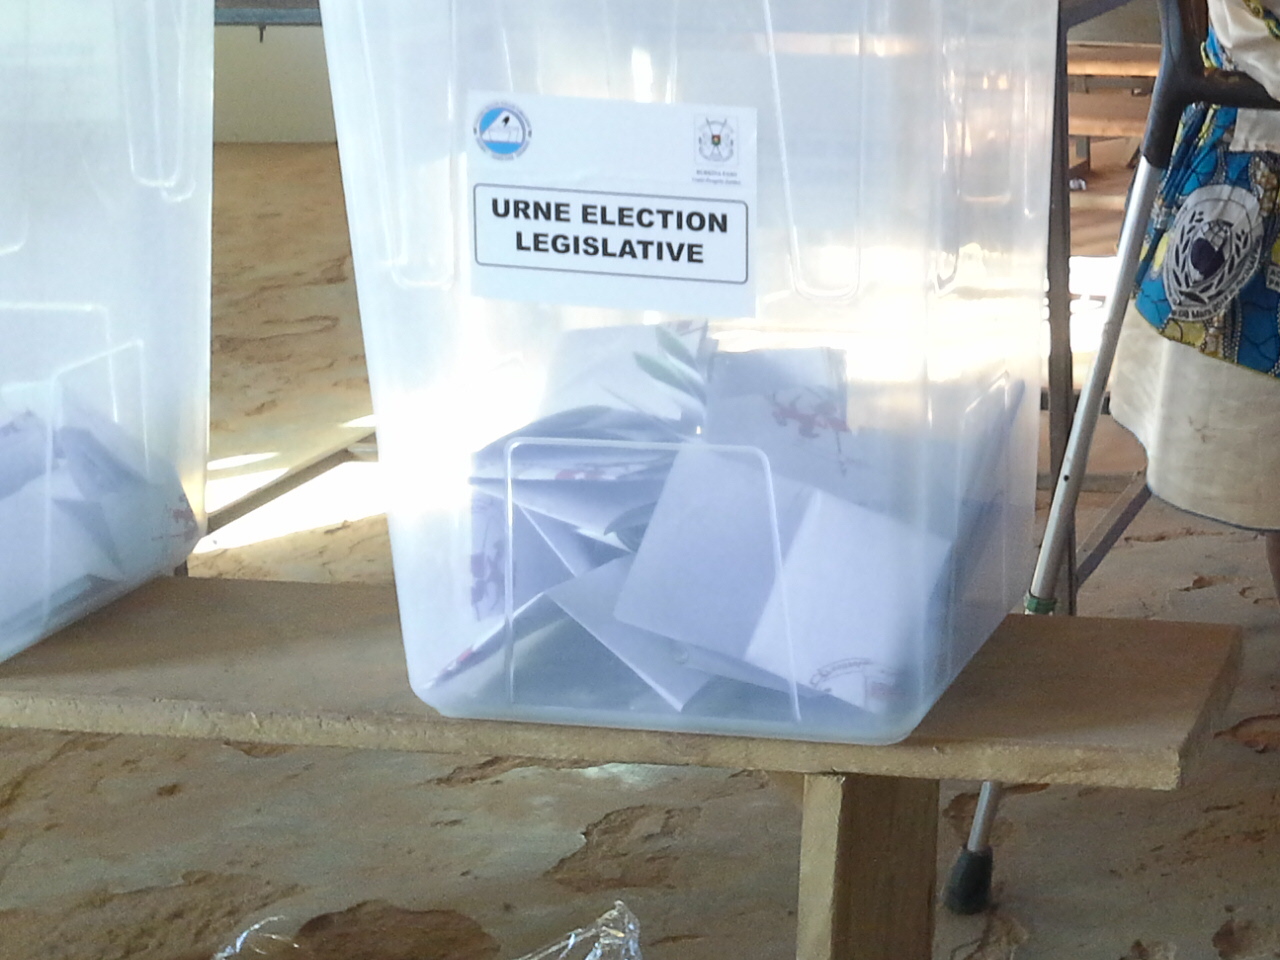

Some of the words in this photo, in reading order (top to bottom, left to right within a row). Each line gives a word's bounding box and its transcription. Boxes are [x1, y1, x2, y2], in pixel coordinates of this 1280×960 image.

[491, 198, 571, 223] URNE
[581, 205, 728, 233] ELECTION
[515, 231, 704, 263] LEGISLATIVE
